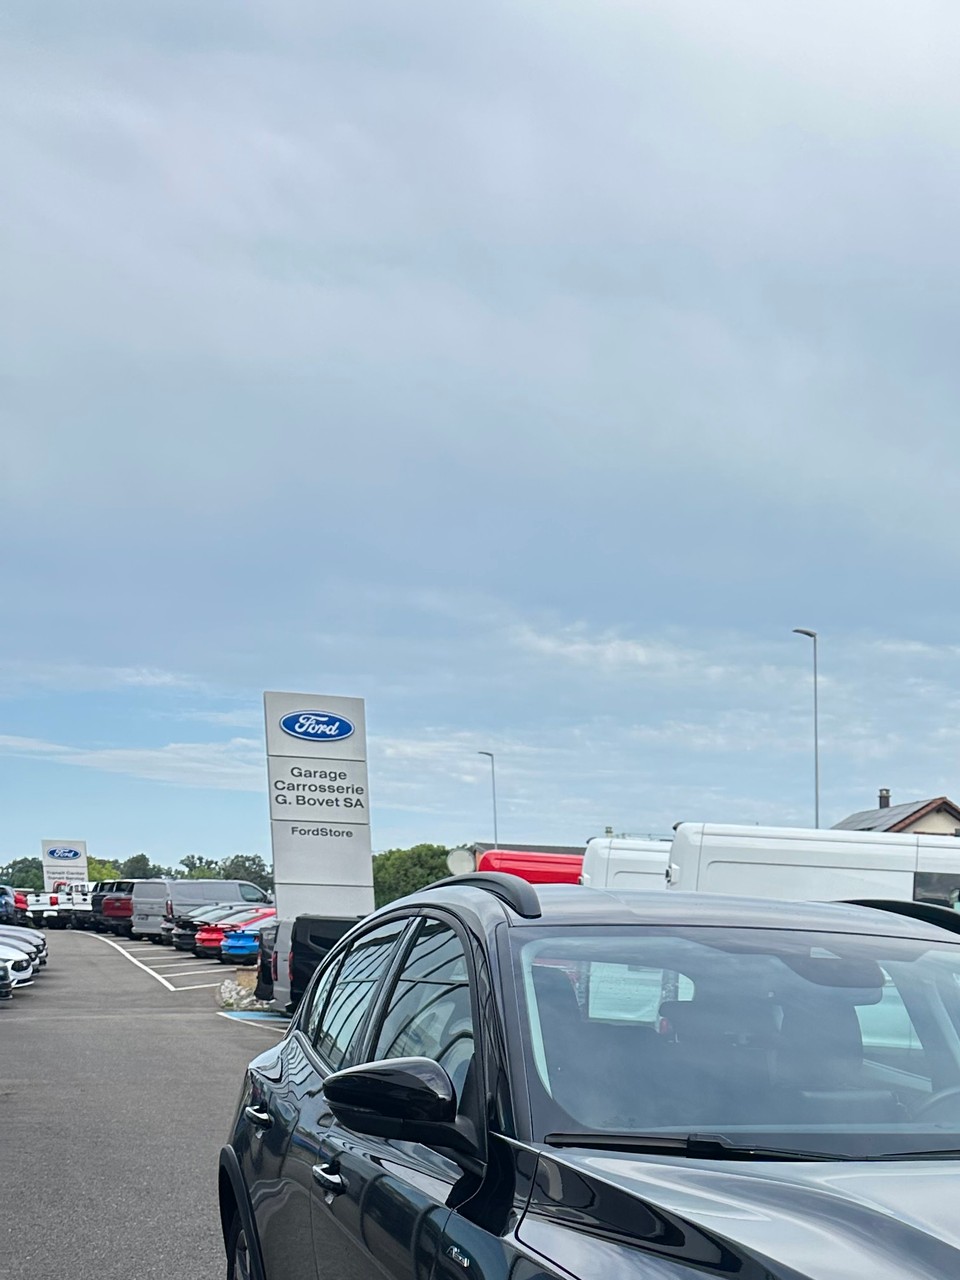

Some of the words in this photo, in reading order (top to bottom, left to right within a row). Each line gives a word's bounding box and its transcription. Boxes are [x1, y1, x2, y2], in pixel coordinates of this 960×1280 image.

[295, 715, 340, 735] Ford
[290, 766, 347, 782] Garage
[274, 780, 364, 795] Carrosserie
[275, 794, 292, 805] G.
[296, 795, 340, 807] Bovet
[343, 797, 364, 808] SA
[291, 826, 353, 837] FordStore
